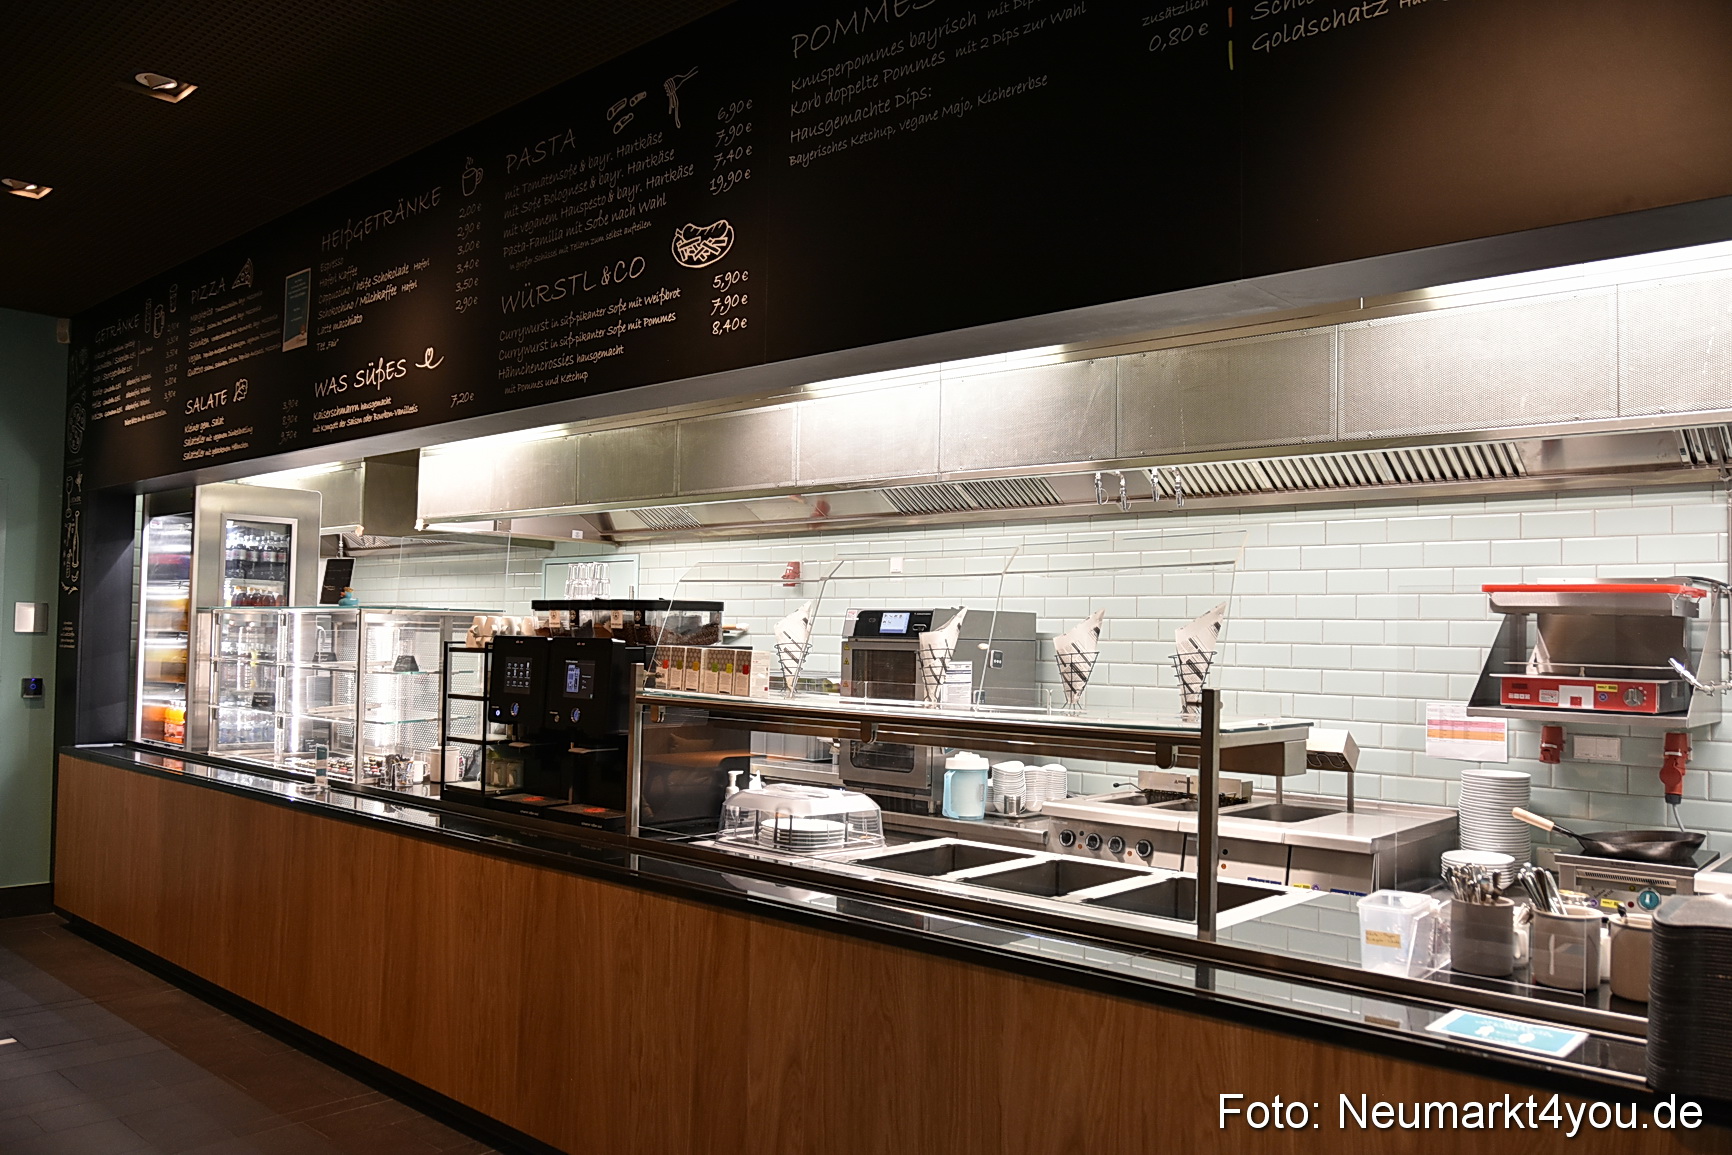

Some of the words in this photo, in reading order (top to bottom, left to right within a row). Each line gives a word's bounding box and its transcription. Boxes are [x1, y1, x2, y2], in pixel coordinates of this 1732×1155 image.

[1148, 24, 1194, 52] 0,80
[1251, 0, 1389, 53] Goldschatz
[790, 92, 821, 117] Korb
[825, 74, 879, 105] doppelte
[883, 51, 946, 83] Pommes
[955, 40, 978, 58] mit
[980, 37, 990, 50] 2
[992, 26, 1019, 46] Dips
[1023, 18, 1047, 35] zur
[1050, 0, 1087, 25] Wahl
[791, 40, 905, 93] Knusperpommes
[909, 11, 977, 50] bayrisch
[987, 2, 1010, 20] mit
[717, 100, 745, 124] 6,90
[788, 140, 848, 168] Bayerisches
[850, 125, 896, 147] Ketchup,
[899, 110, 939, 131] vegane
[941, 97, 973, 118] Majo,
[977, 74, 1048, 107] Kichererbse
[790, 99, 891, 143] Hausgemachte
[894, 87, 932, 110] Dips:
[505, 128, 577, 174] PASTA
[715, 123, 744, 148] 7,90
[504, 185, 520, 200] mit
[588, 152, 613, 172] bayr.
[616, 131, 663, 158] Hartkäse
[713, 146, 744, 171] 7,40
[504, 204, 519, 219] mit
[543, 180, 588, 206] Bolognese
[598, 169, 624, 188] bayr.
[627, 148, 675, 175] Hartkäse
[709, 169, 743, 196] 19,90
[503, 223, 519, 239] mit
[520, 213, 559, 235] veganem
[560, 195, 607, 218] Hauspesto
[616, 183, 643, 203] bayr.
[646, 163, 694, 190] Hartkäse
[503, 228, 564, 258] Pasta-Familia
[565, 220, 583, 237] mit
[611, 204, 636, 223] nach
[638, 192, 667, 213] Wahl
[605, 228, 623, 241] selbst
[191, 277, 226, 304] PIZZA
[501, 270, 597, 314] WÜRSTL
[712, 270, 740, 293] 5,90
[499, 318, 550, 344] Currywurst
[551, 318, 559, 328] in
[628, 296, 643, 309] mit
[644, 287, 682, 306] Weißbrot
[710, 293, 740, 316] 7,90
[498, 338, 549, 363] Currywurst
[550, 338, 558, 348] in
[627, 318, 642, 331] mit
[643, 312, 677, 328] Pommes
[711, 317, 740, 336] 8,40
[498, 353, 574, 380] Hähnchencrossies
[576, 344, 624, 364] hausgemacht
[314, 374, 348, 398] WAS
[517, 378, 544, 392] Pommes
[544, 374, 560, 387] und
[560, 370, 589, 383] Ketchup
[184, 389, 228, 415] SALATE
